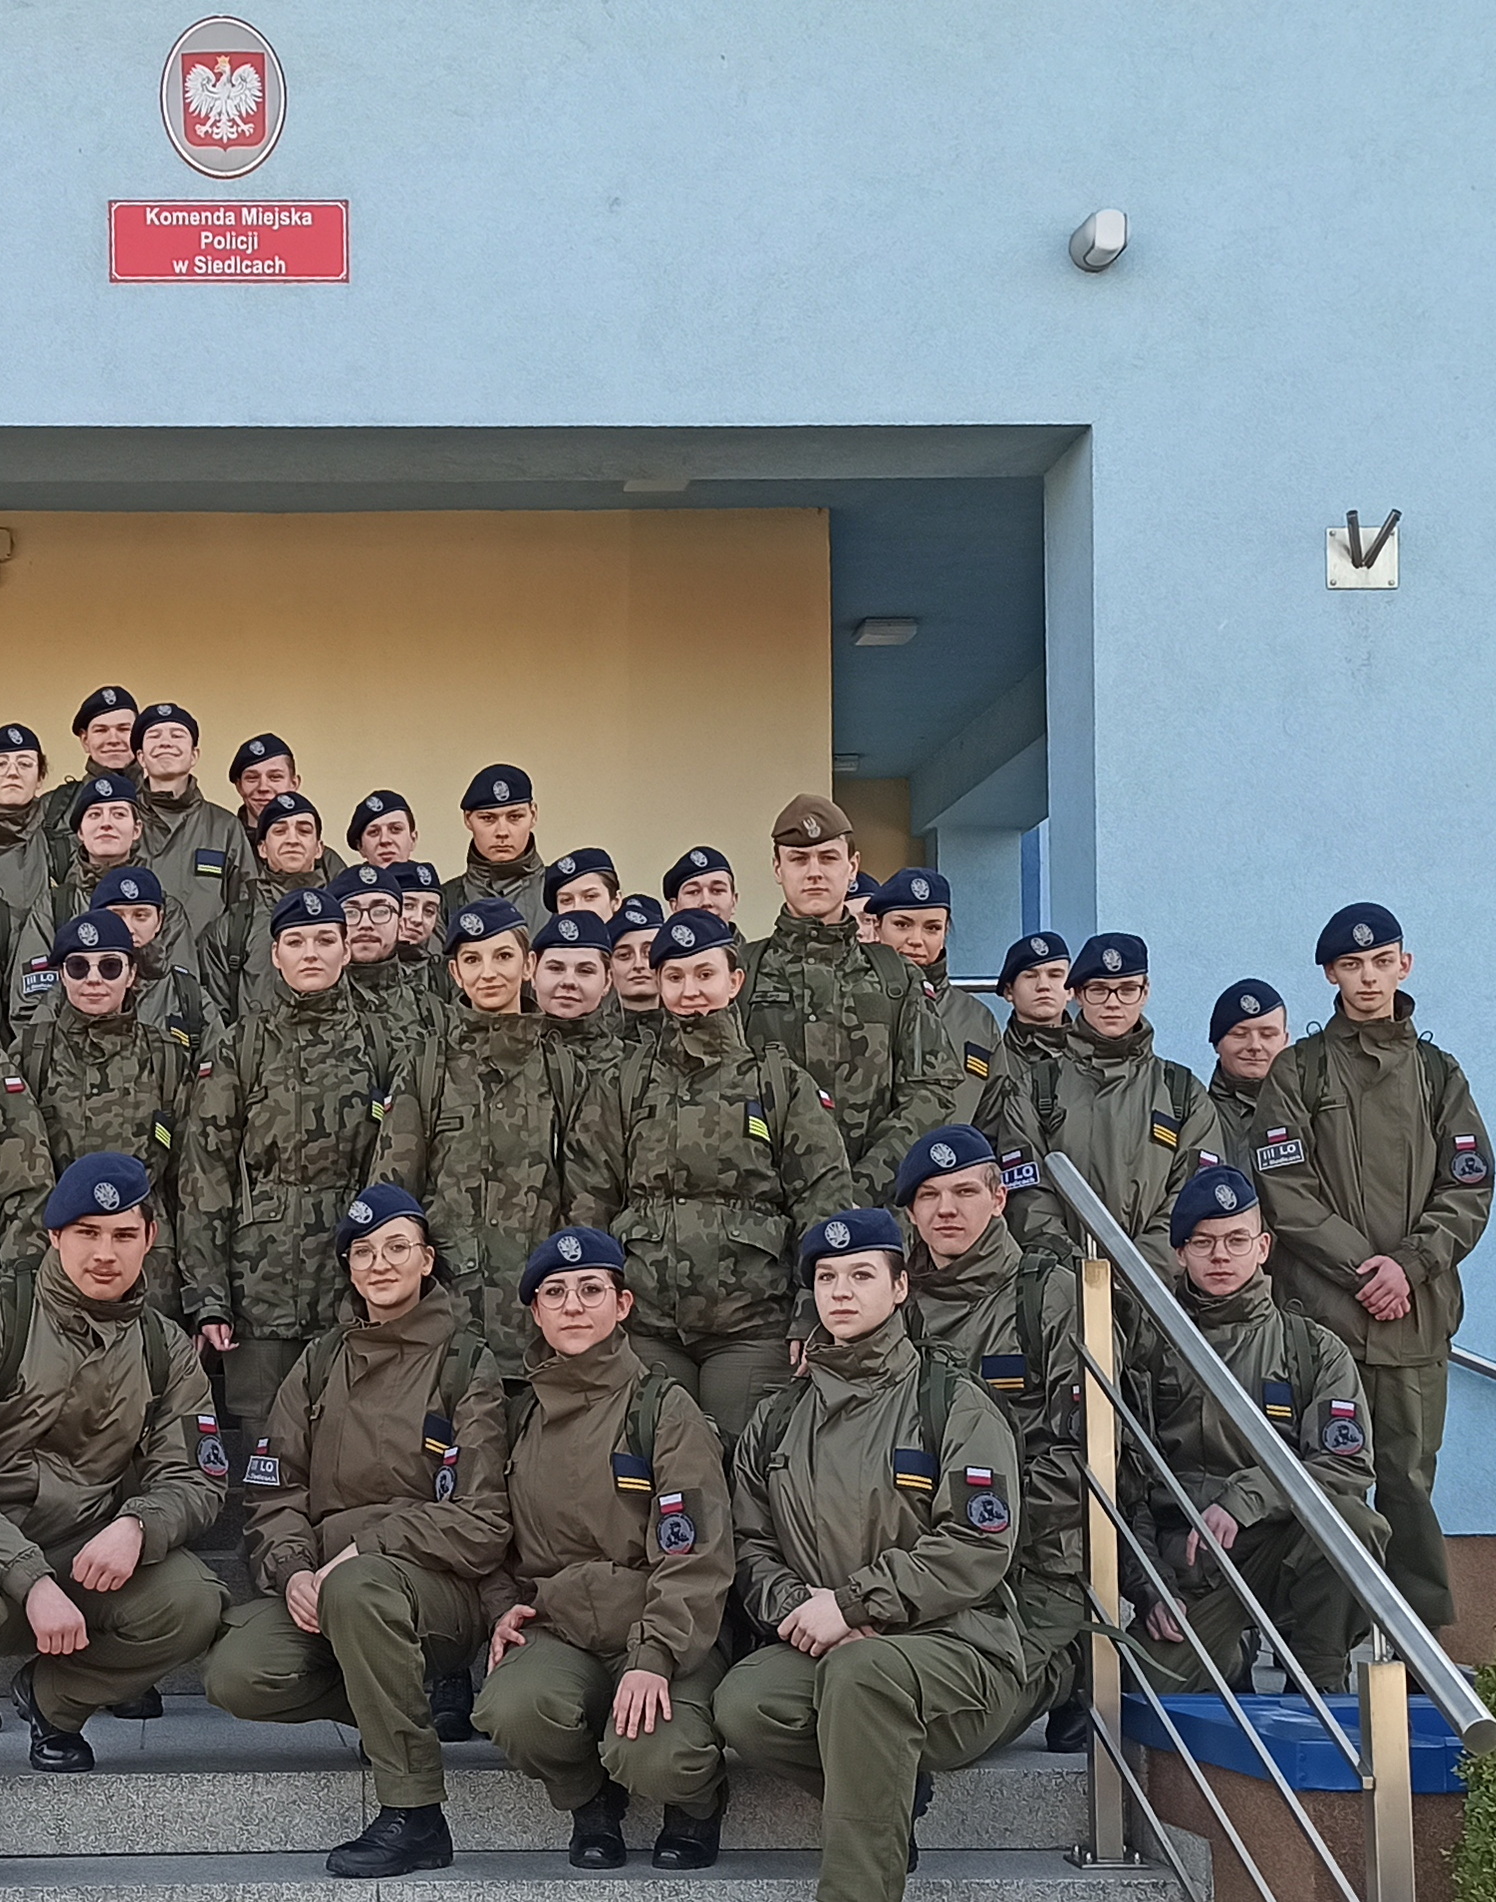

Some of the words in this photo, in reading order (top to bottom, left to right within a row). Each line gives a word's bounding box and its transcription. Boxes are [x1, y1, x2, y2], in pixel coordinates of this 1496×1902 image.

[145, 207, 236, 226] Komenda
[241, 207, 313, 230] Miejska
[200, 231, 259, 254] Policji
[172, 258, 189, 274] w
[194, 256, 286, 274] Siedlcach
[40, 973, 55, 982] LO
[1262, 1148, 1275, 1160] III
[1279, 1144, 1297, 1155] LO
[1013, 1165, 1034, 1180] LO
[260, 1460, 274, 1473] LO
